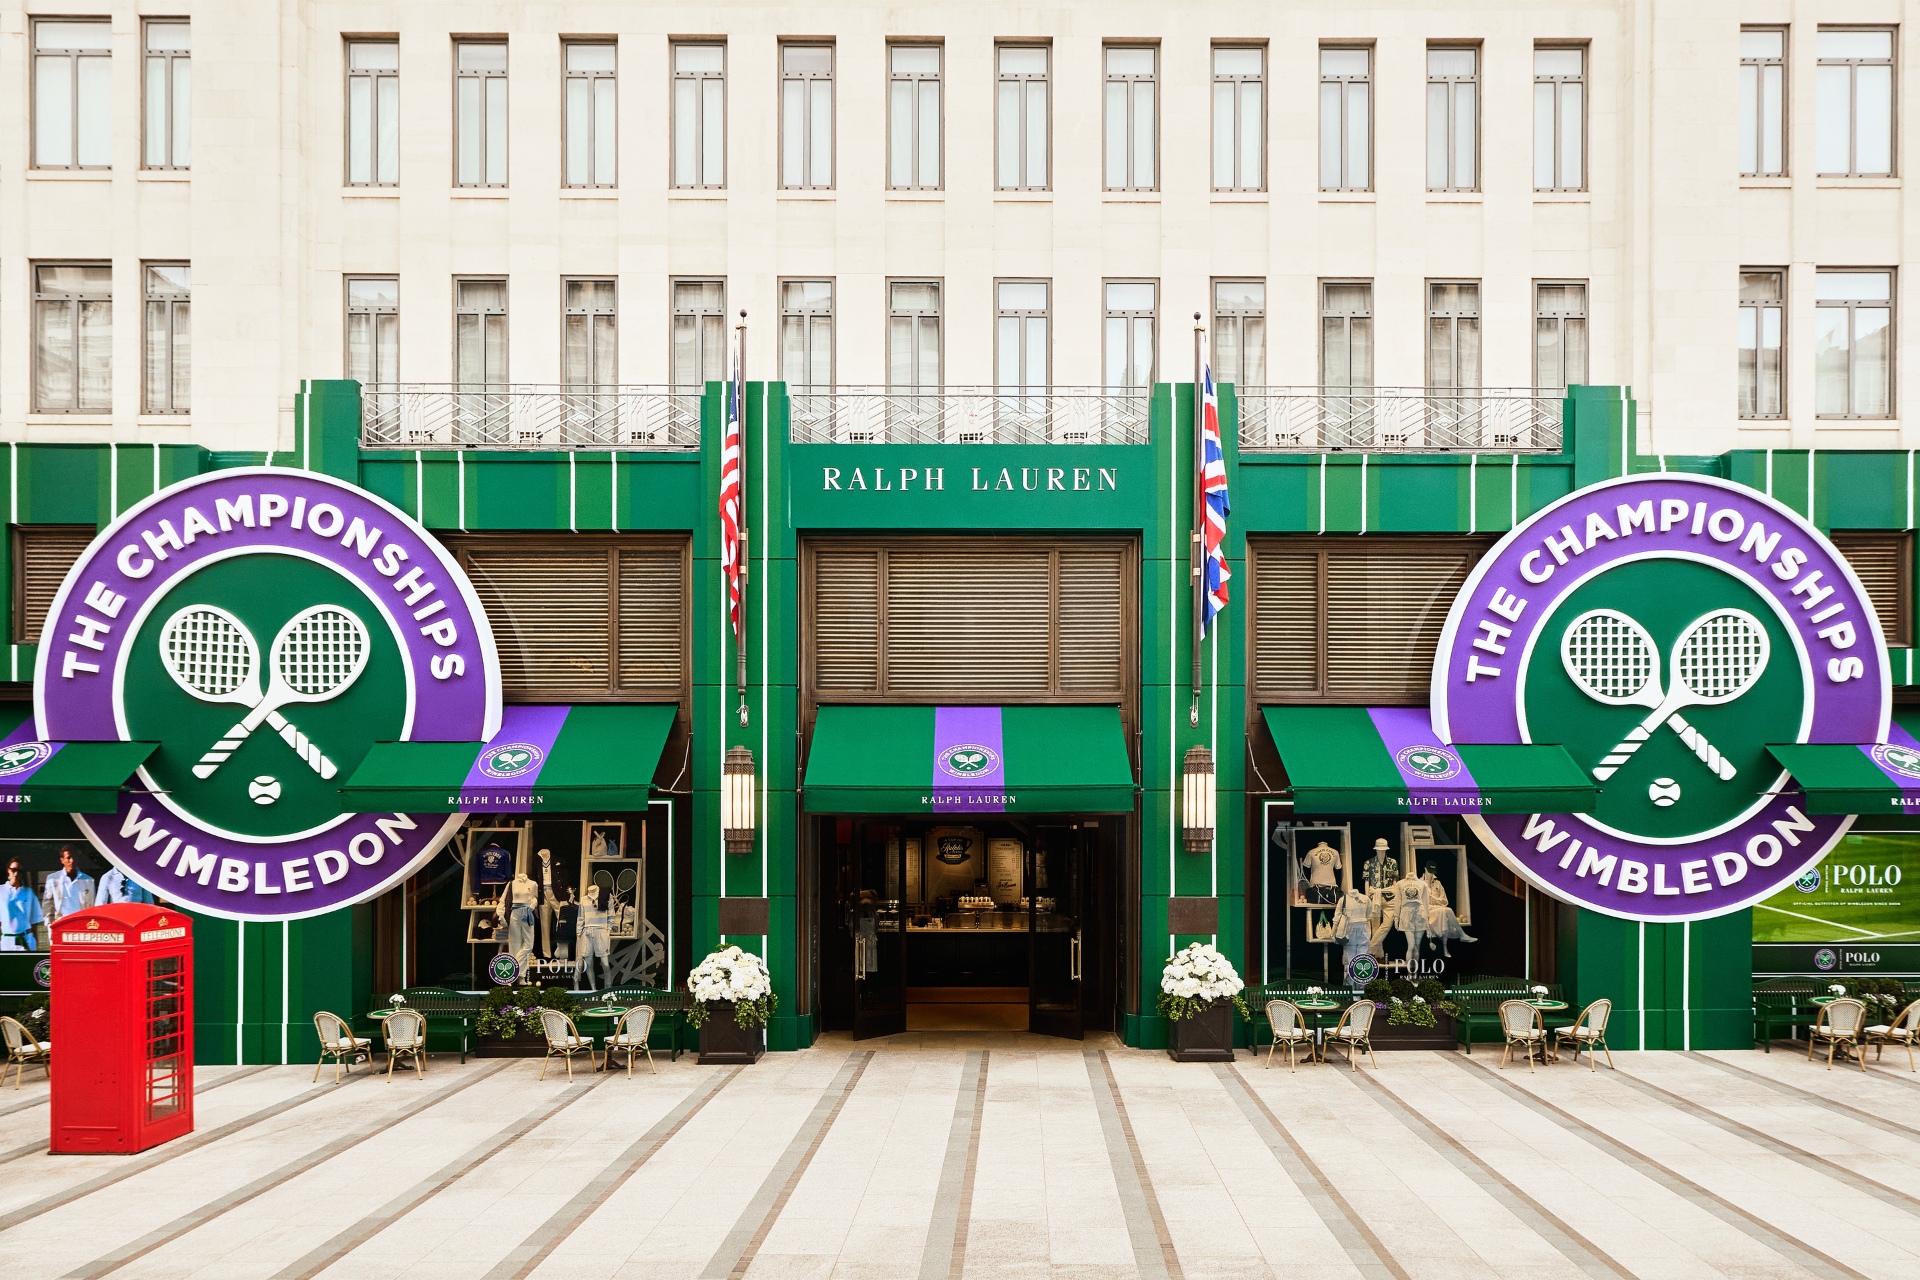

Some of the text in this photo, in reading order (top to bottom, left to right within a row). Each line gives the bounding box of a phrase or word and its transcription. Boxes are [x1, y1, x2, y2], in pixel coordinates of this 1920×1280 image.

[822, 467, 1118, 491] RALPH LAUREN
[61, 493, 466, 681] THE CHAMPIONSHIPS
[1466, 498, 1865, 684] THE CHAMPIONSHIPS
[448, 796, 544, 804] RALPH LAUREN
[921, 795, 1016, 804] RALPH LAUREN
[1397, 797, 1492, 805] RALPH LAUREN
[119, 803, 418, 895] WIMBLEDON
[1520, 805, 1817, 897] WIMBLEDON
[1833, 865, 1902, 886] POLO
[66, 933, 121, 942] TELEPHONE
[142, 928, 184, 941] TELEPHONE
[1846, 952, 1880, 963] POLO
[536, 959, 587, 974] POLO
[1394, 959, 1445, 974] POLO
